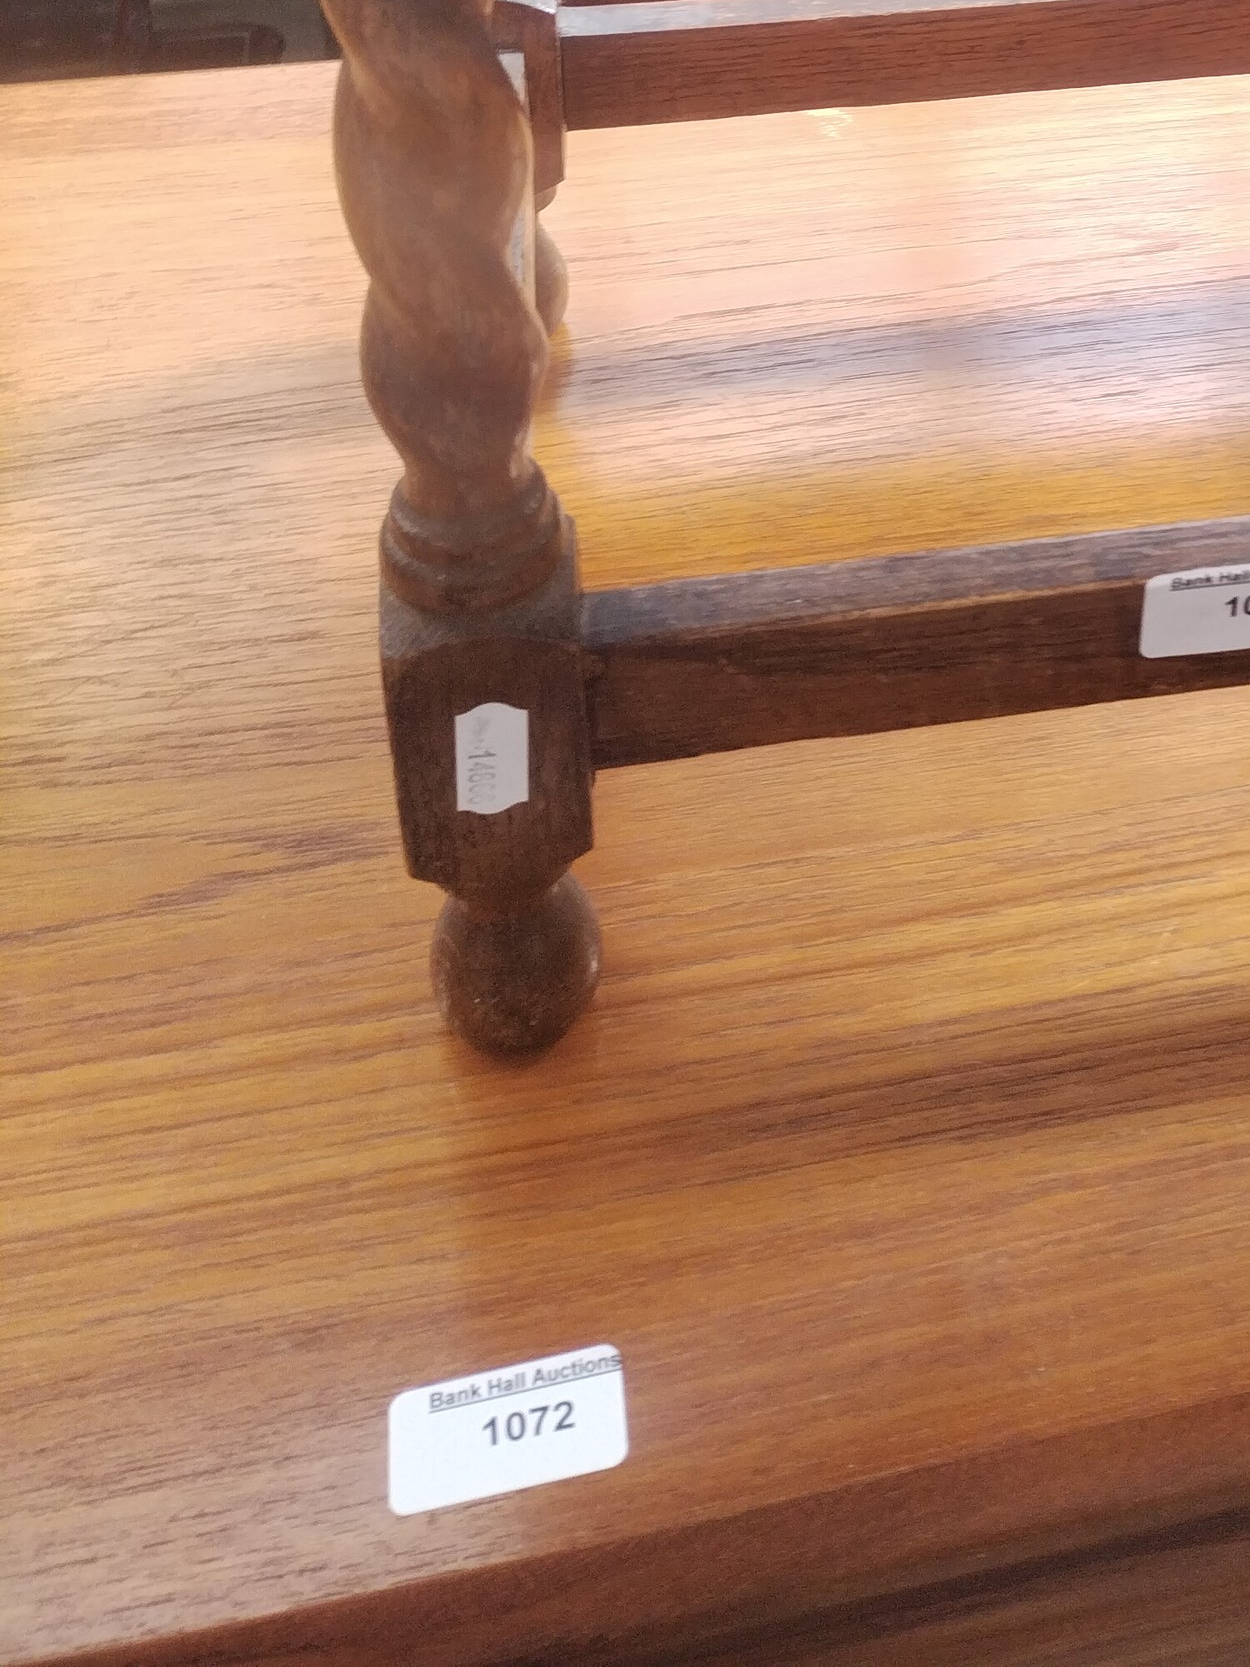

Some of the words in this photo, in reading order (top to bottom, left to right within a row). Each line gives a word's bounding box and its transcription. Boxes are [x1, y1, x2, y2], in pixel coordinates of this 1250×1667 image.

[1171, 574, 1213, 589] Bank
[1218, 571, 1250, 583] Hall
[429, 1383, 482, 1410] Bank
[487, 1372, 527, 1395] Hall
[531, 1353, 621, 1387] Auctions
[481, 1400, 576, 1446] 1072
